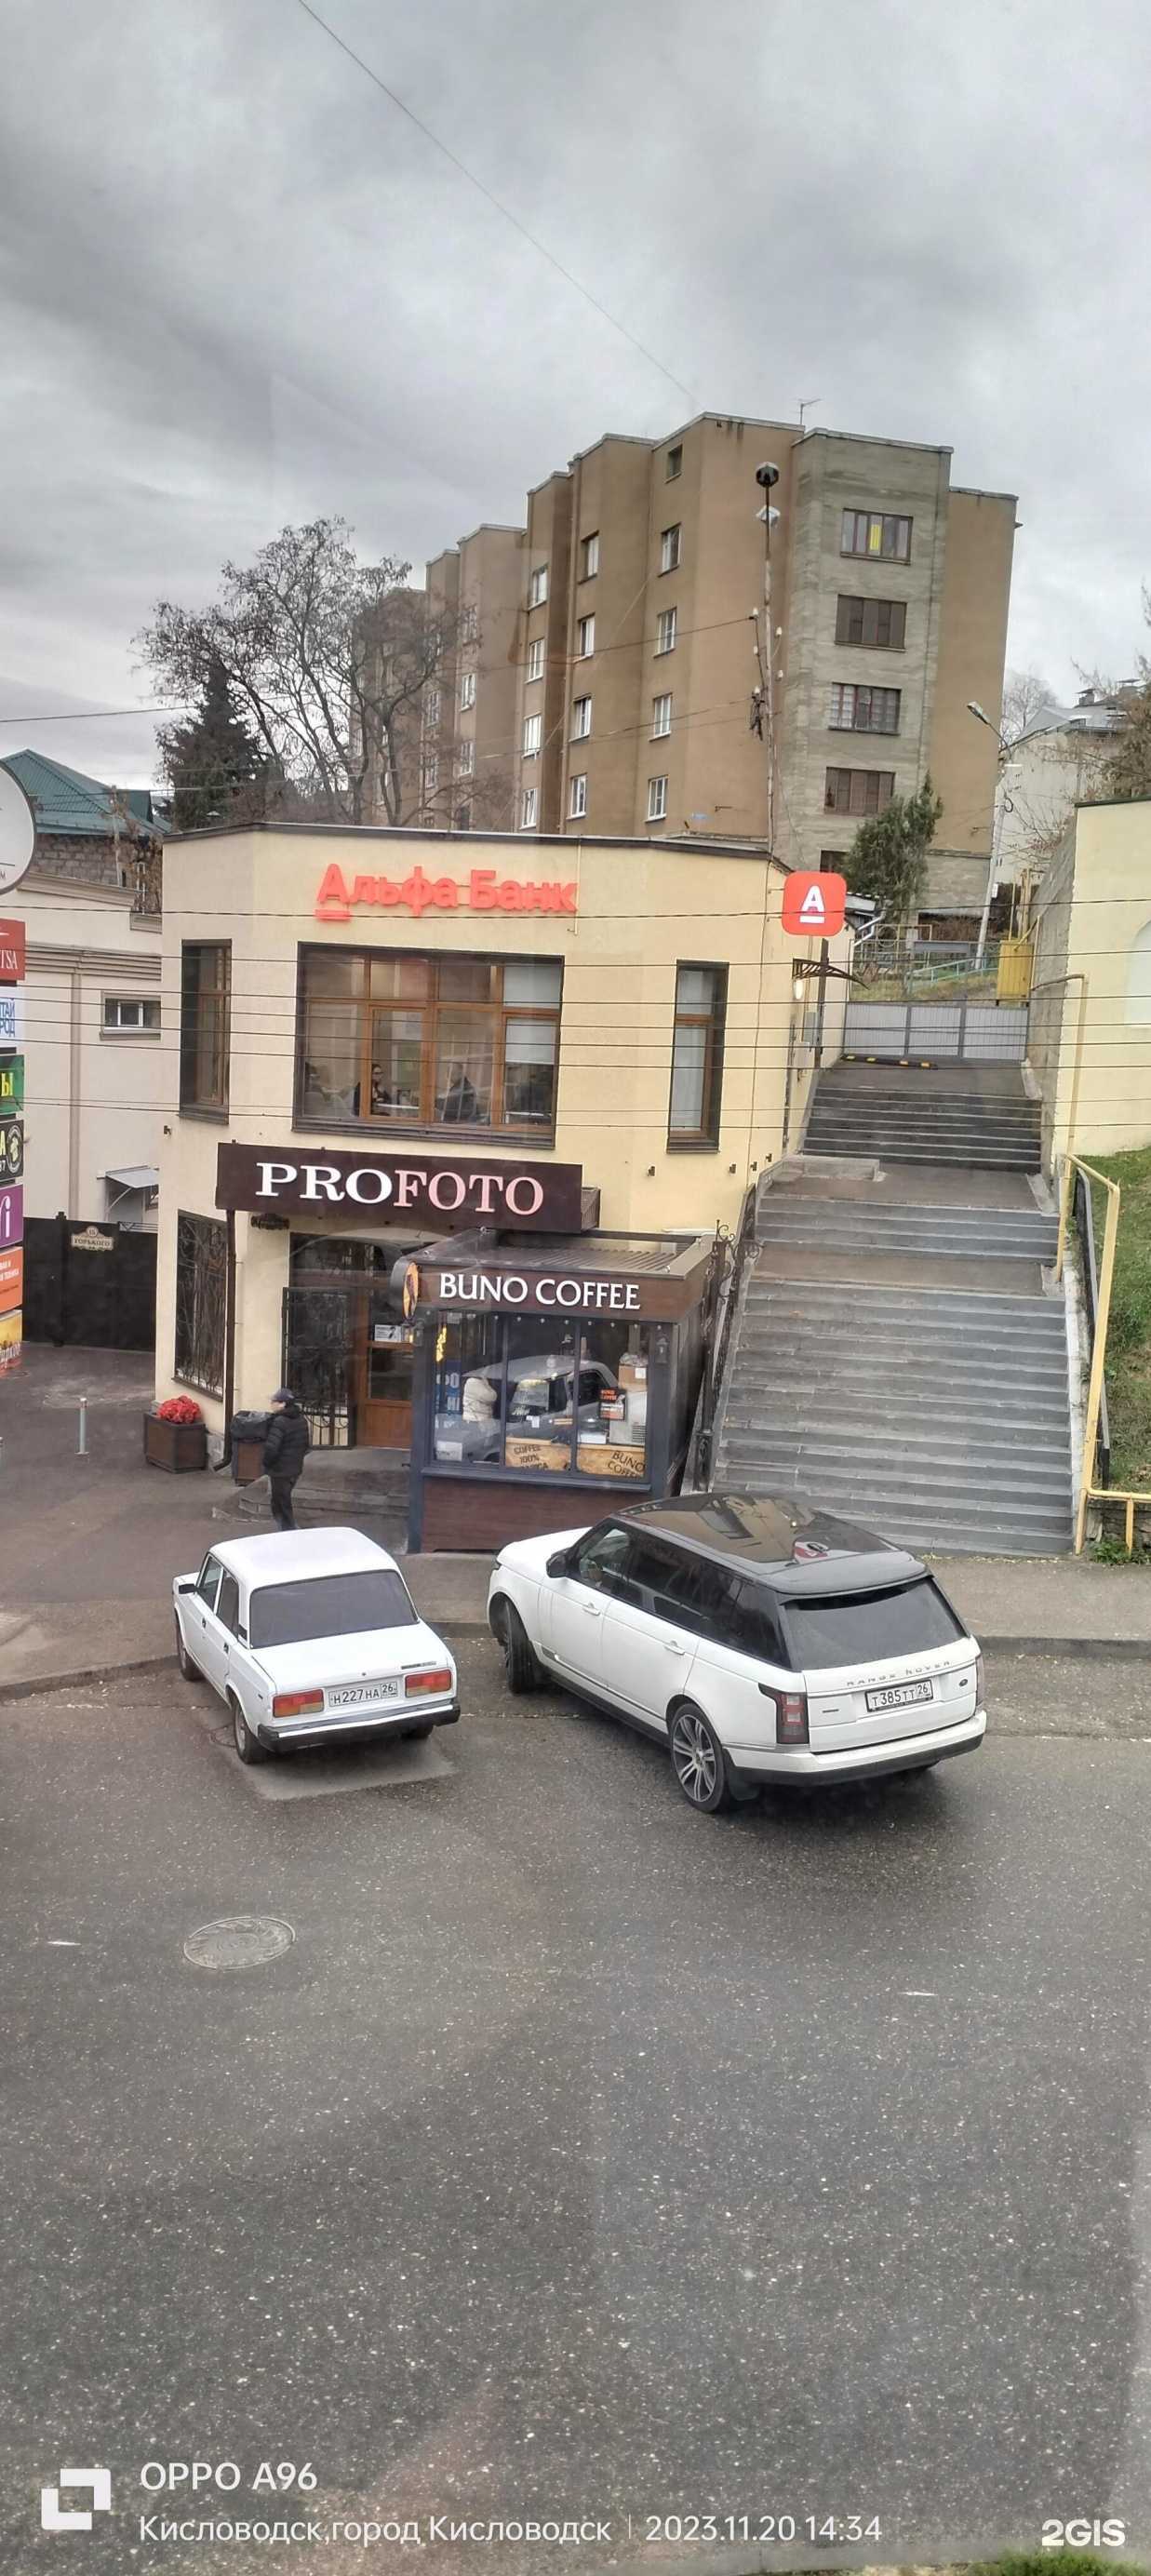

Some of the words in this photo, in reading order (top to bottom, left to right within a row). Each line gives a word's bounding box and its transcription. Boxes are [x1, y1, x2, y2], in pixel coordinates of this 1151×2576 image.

[317, 864, 458, 918] Альфа
[470, 869, 578, 913] Банк
[255, 1162, 544, 1215] PROFOTO
[439, 1272, 529, 1303] BUNO
[535, 1279, 641, 1310] COFFEE
[611, 1450, 646, 1473] BUNO
